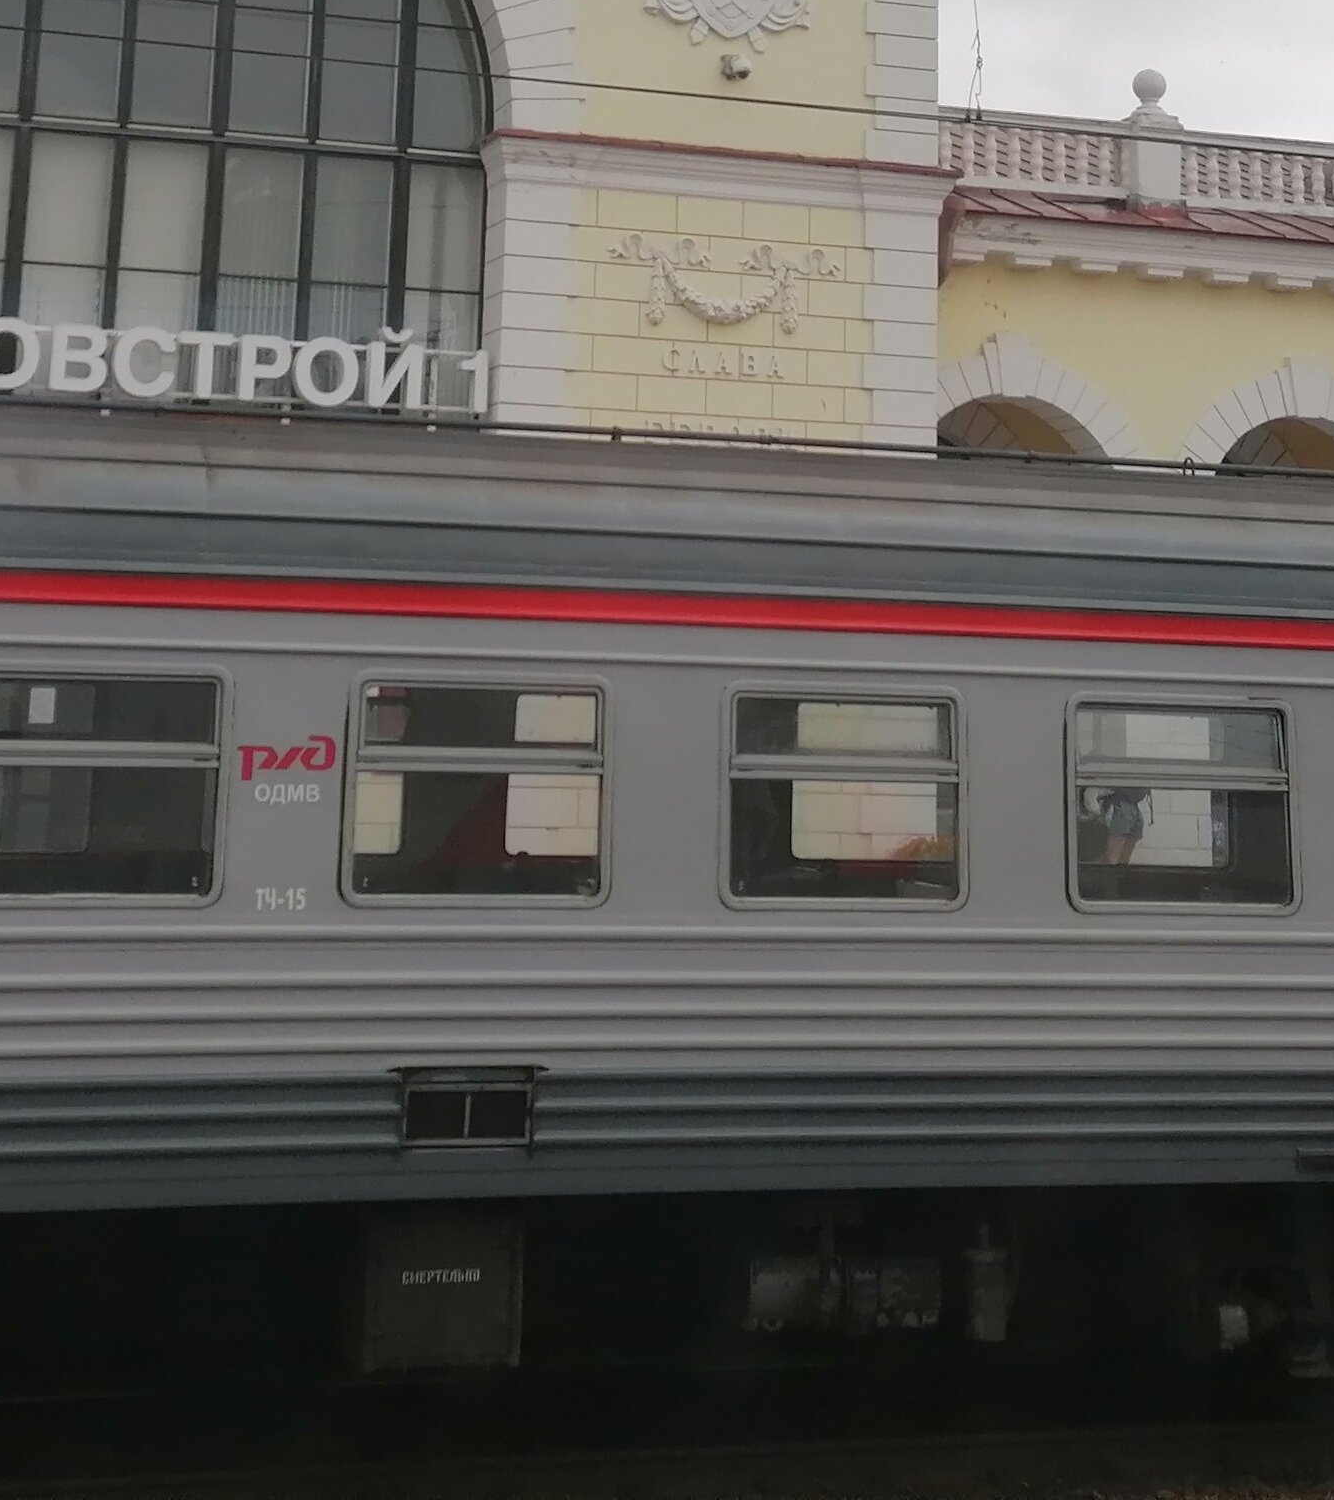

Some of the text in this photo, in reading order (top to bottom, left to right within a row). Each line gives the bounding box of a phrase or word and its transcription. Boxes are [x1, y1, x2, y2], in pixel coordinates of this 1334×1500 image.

[462, 350, 490, 414] 1
[254, 782, 320, 805] ОДМВ
[254, 886, 308, 911] ТЧ-15
